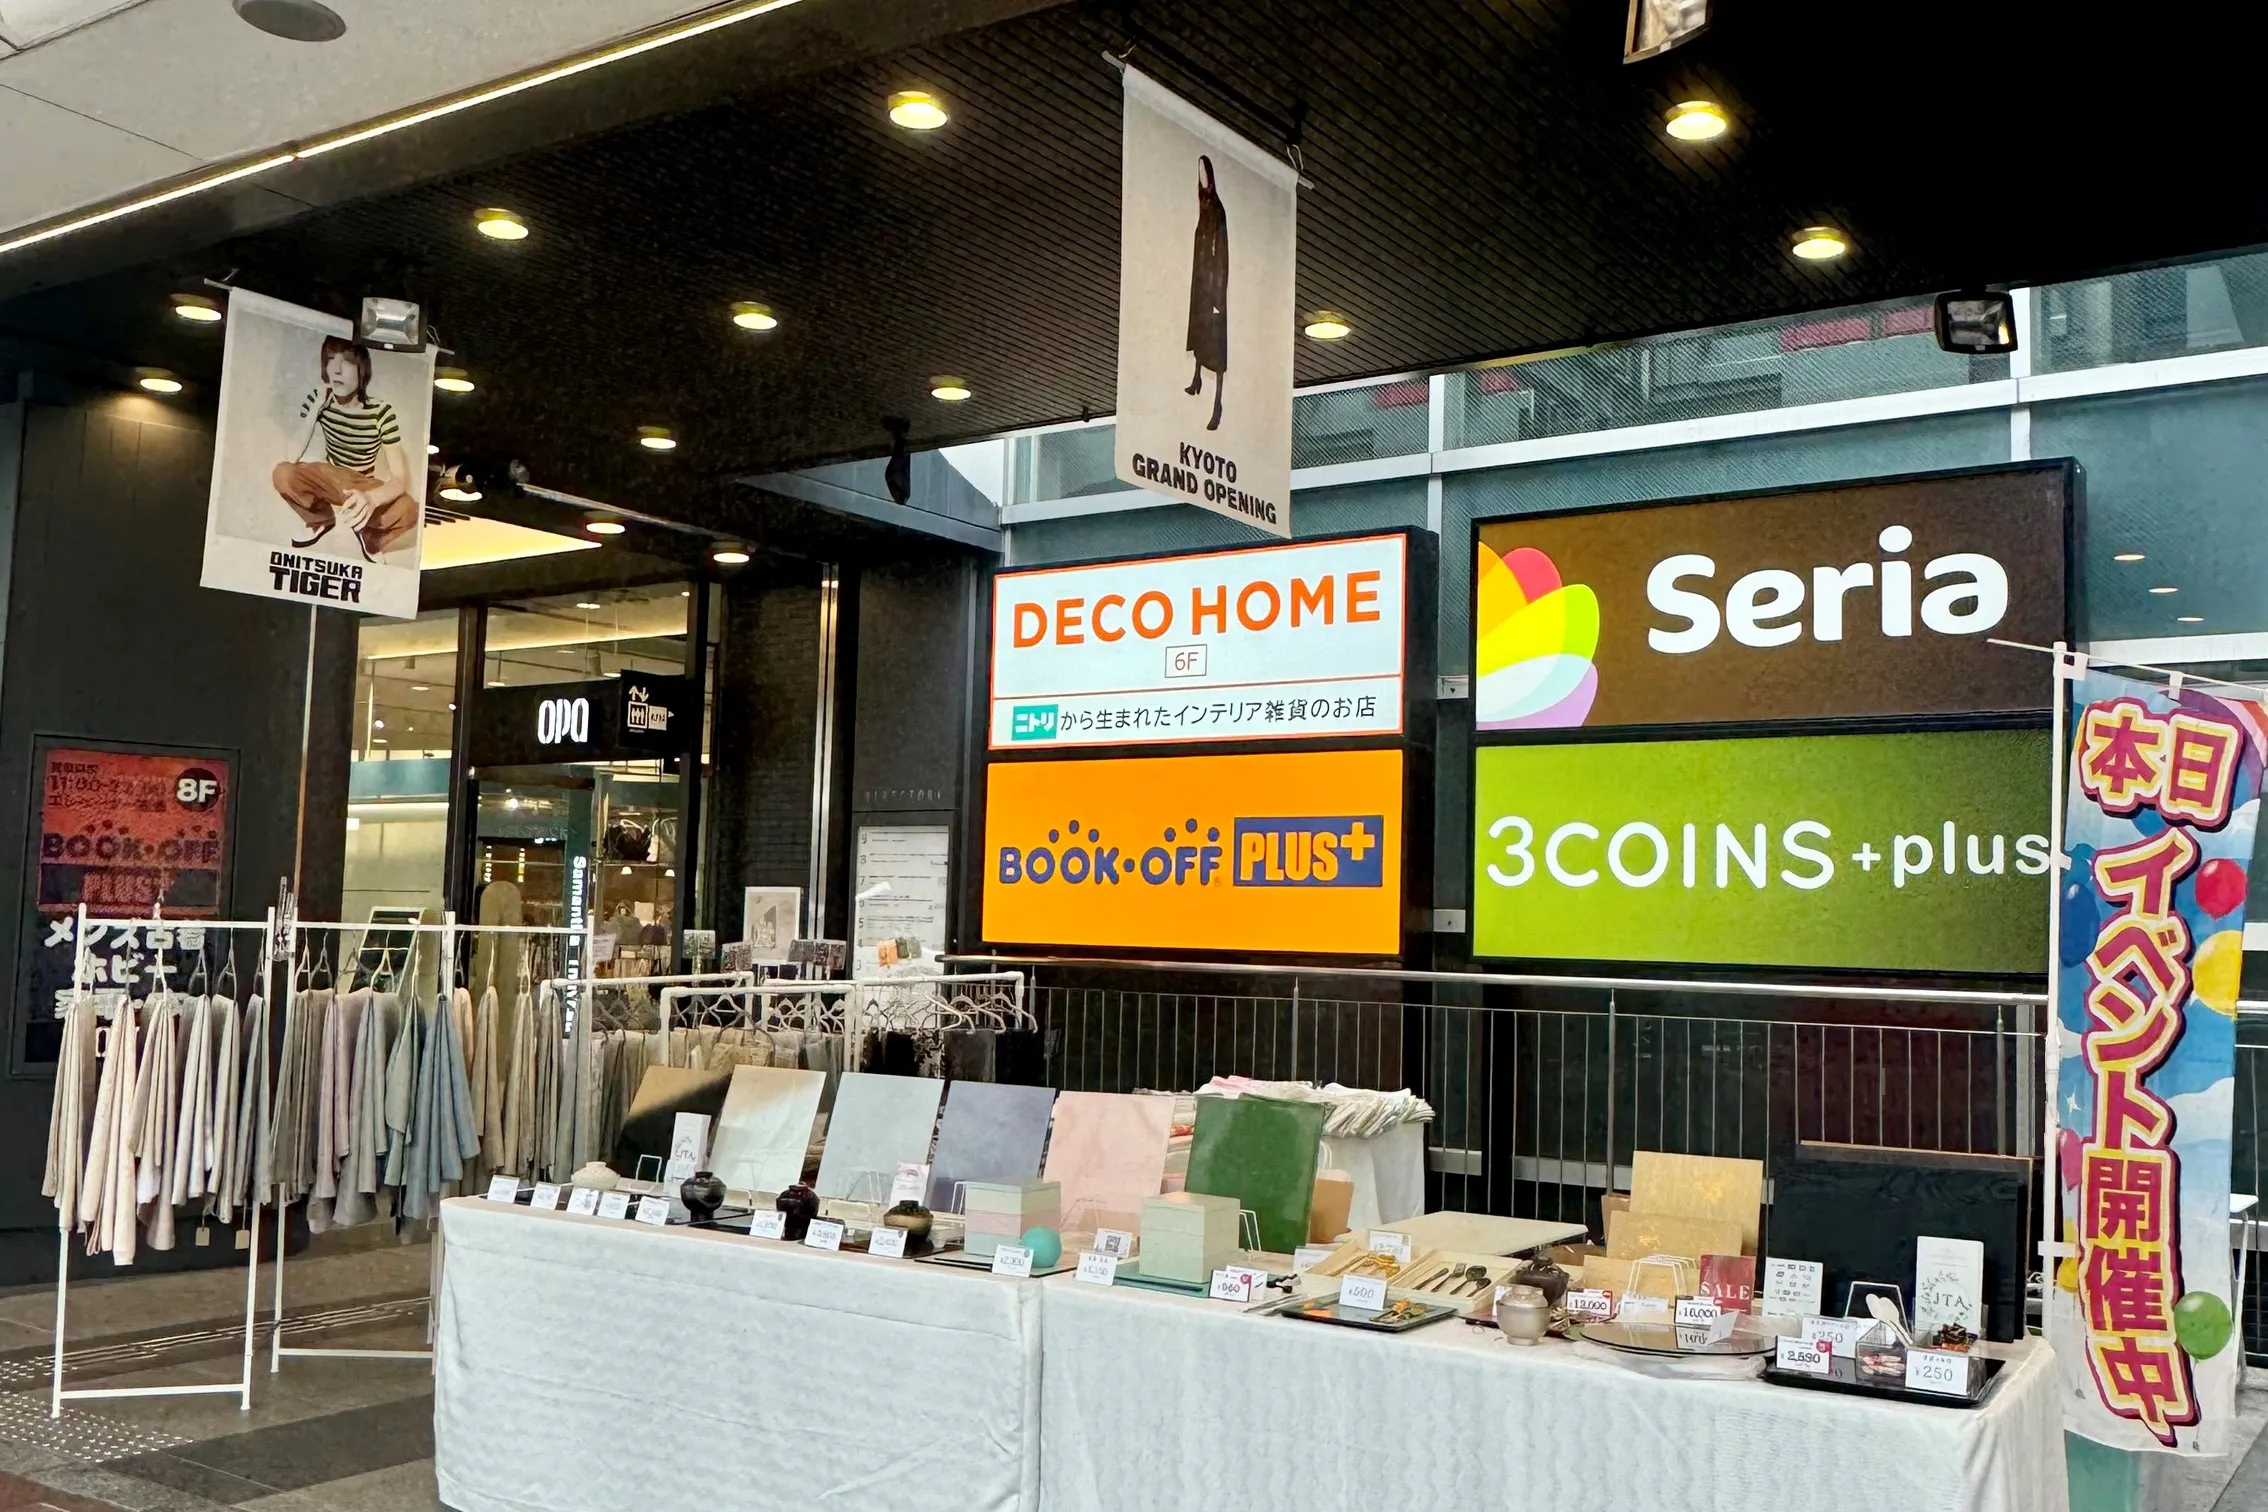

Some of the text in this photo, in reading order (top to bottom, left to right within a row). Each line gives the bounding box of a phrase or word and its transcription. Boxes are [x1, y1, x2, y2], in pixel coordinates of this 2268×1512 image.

[1179, 441, 1237, 484] KYOTO
[1132, 452, 1277, 525] GRAND OPENING
[269, 551, 363, 580] ONITSUKA
[269, 565, 362, 604] TIGER
[1012, 569, 1381, 649] DECO HOME
[1646, 524, 2009, 655] Seria
[1173, 651, 1200, 672] 6F
[2088, 713, 2229, 811] 本日
[176, 778, 218, 803] 8F
[1485, 815, 2051, 890] 3COINS +plus
[2081, 836, 2188, 1428] イベント開催中
[1700, 1280, 1751, 1301] SALE
[1914, 1365, 1953, 1382] ¥250
